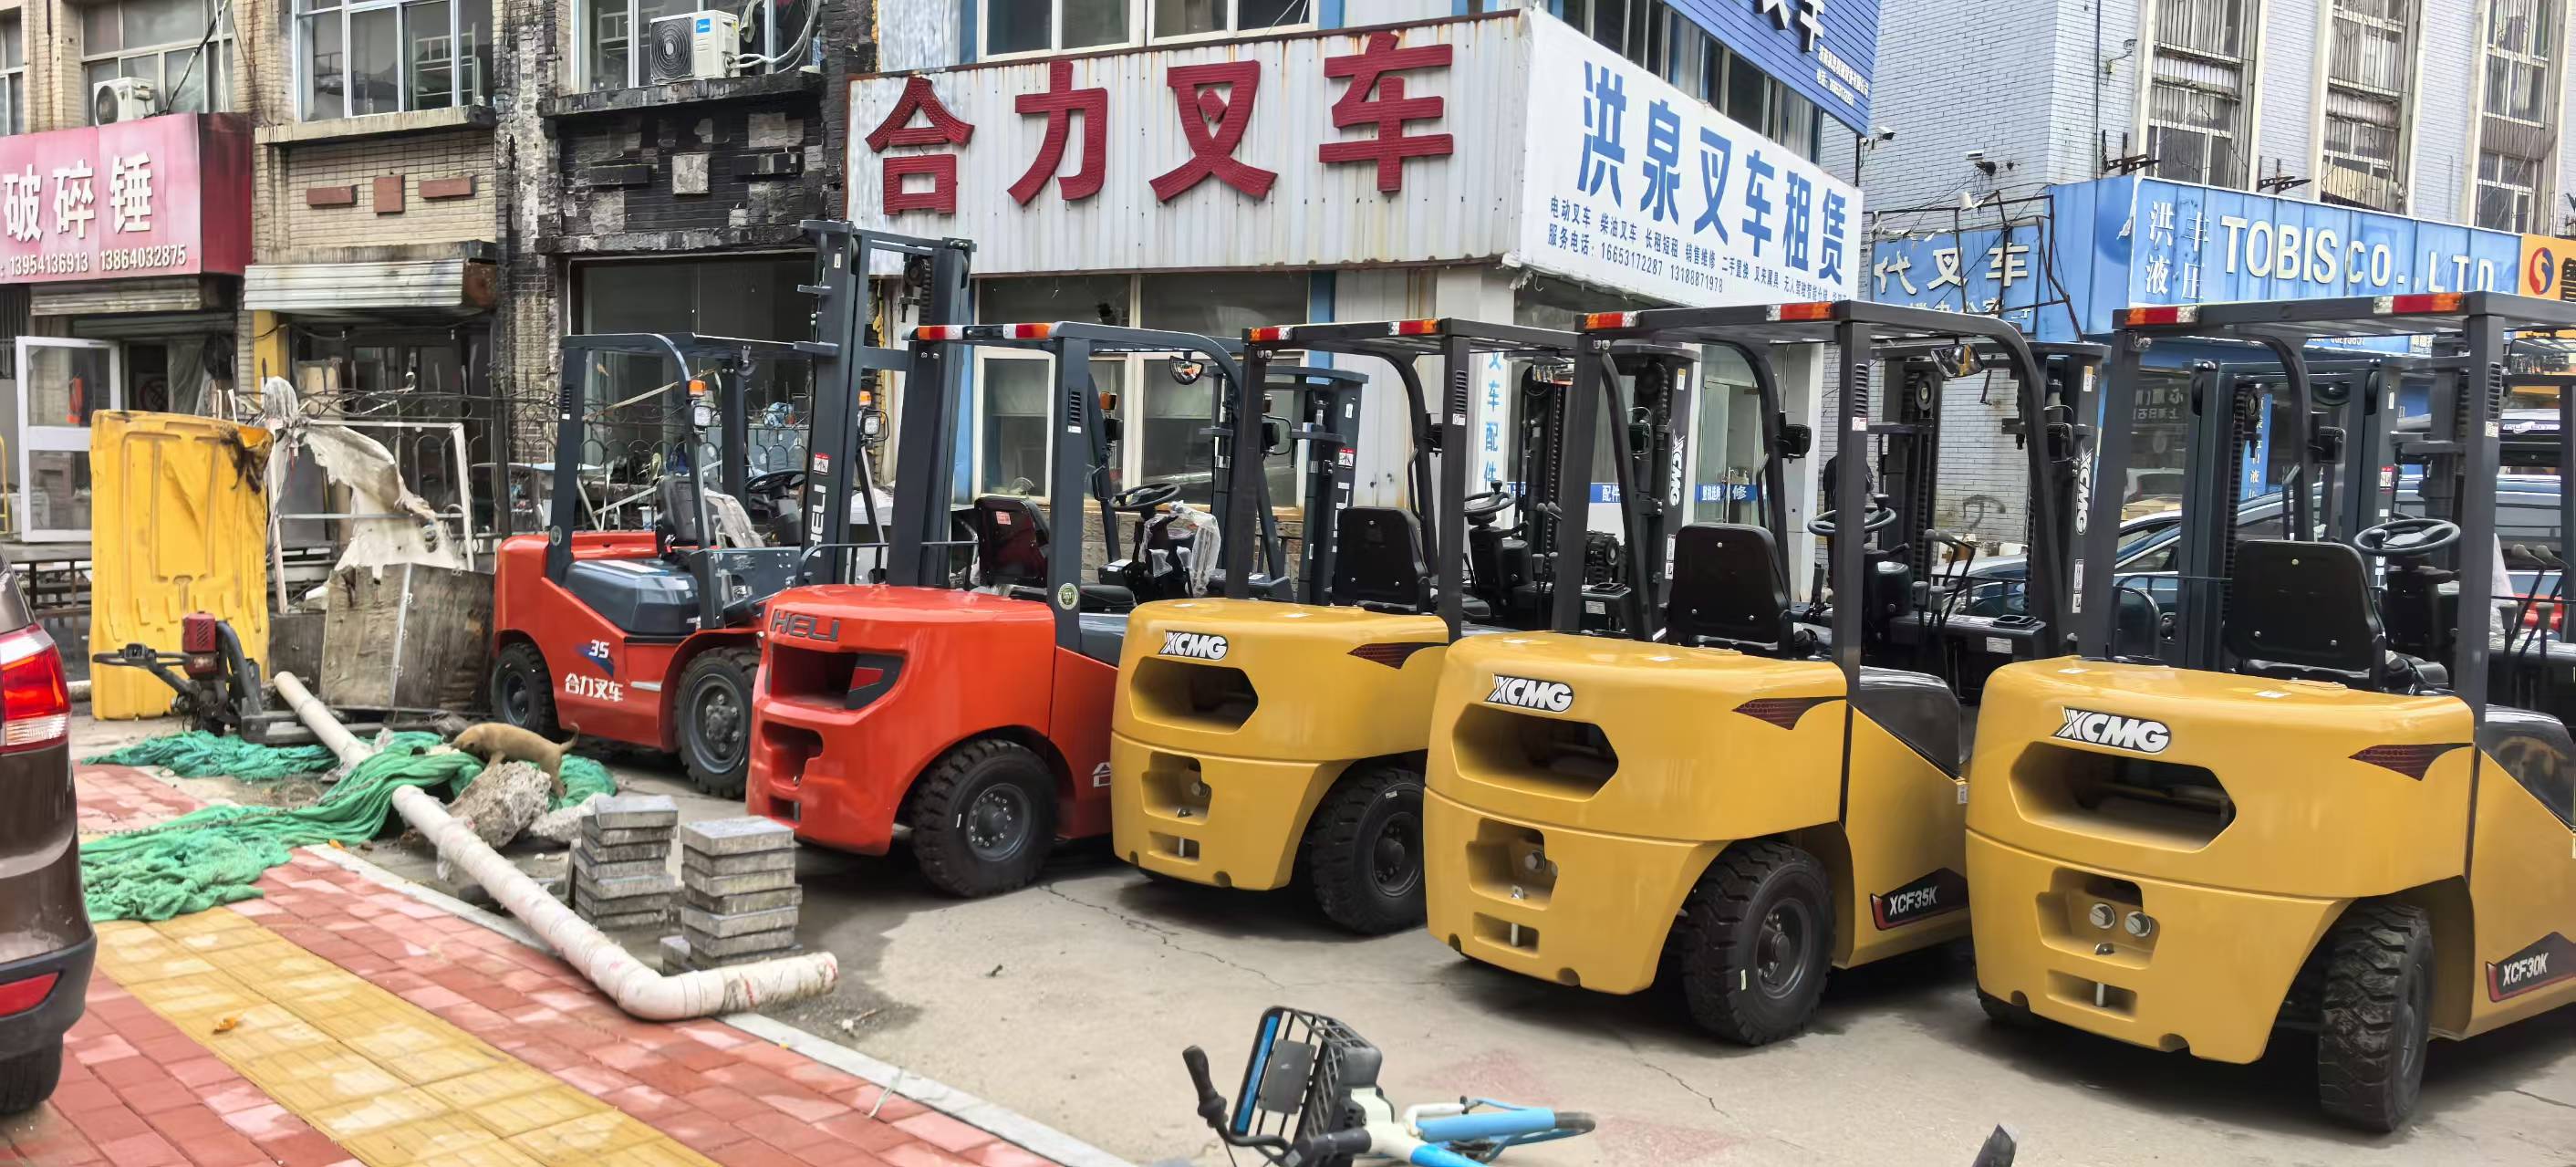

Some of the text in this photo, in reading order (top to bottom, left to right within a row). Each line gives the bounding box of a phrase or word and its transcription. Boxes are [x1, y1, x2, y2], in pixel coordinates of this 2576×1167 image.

[865, 30, 1454, 215] 合力叉车
[2, 151, 152, 242] 破碎锤
[1576, 59, 1847, 287] 洪泉叉车租赁
[1550, 194, 1592, 229] 电动叉车
[1599, 212, 1637, 244] 柴油叉车
[1645, 228, 1678, 258] 长租短租
[2219, 214, 2339, 285] TOBIS
[9, 244, 187, 276] 13954136913 13864032875
[1547, 222, 1723, 293] 服务电话： 16653172287 13188871978
[1874, 242, 2030, 295] 代叉车
[1669, 428, 1686, 506] XCMG
[2075, 445, 2093, 536] XCMG
[810, 484, 826, 557] HELI
[588, 640, 610, 658] 35
[769, 610, 840, 642] HELI
[1159, 630, 1228, 660] XCMG
[565, 672, 624, 702] 合力叉车
[1487, 674, 1573, 712] XCMG
[2055, 707, 2170, 753] XCMG
[1889, 886, 1937, 916] XCF35K
[2502, 952, 2549, 986] XCF30K
